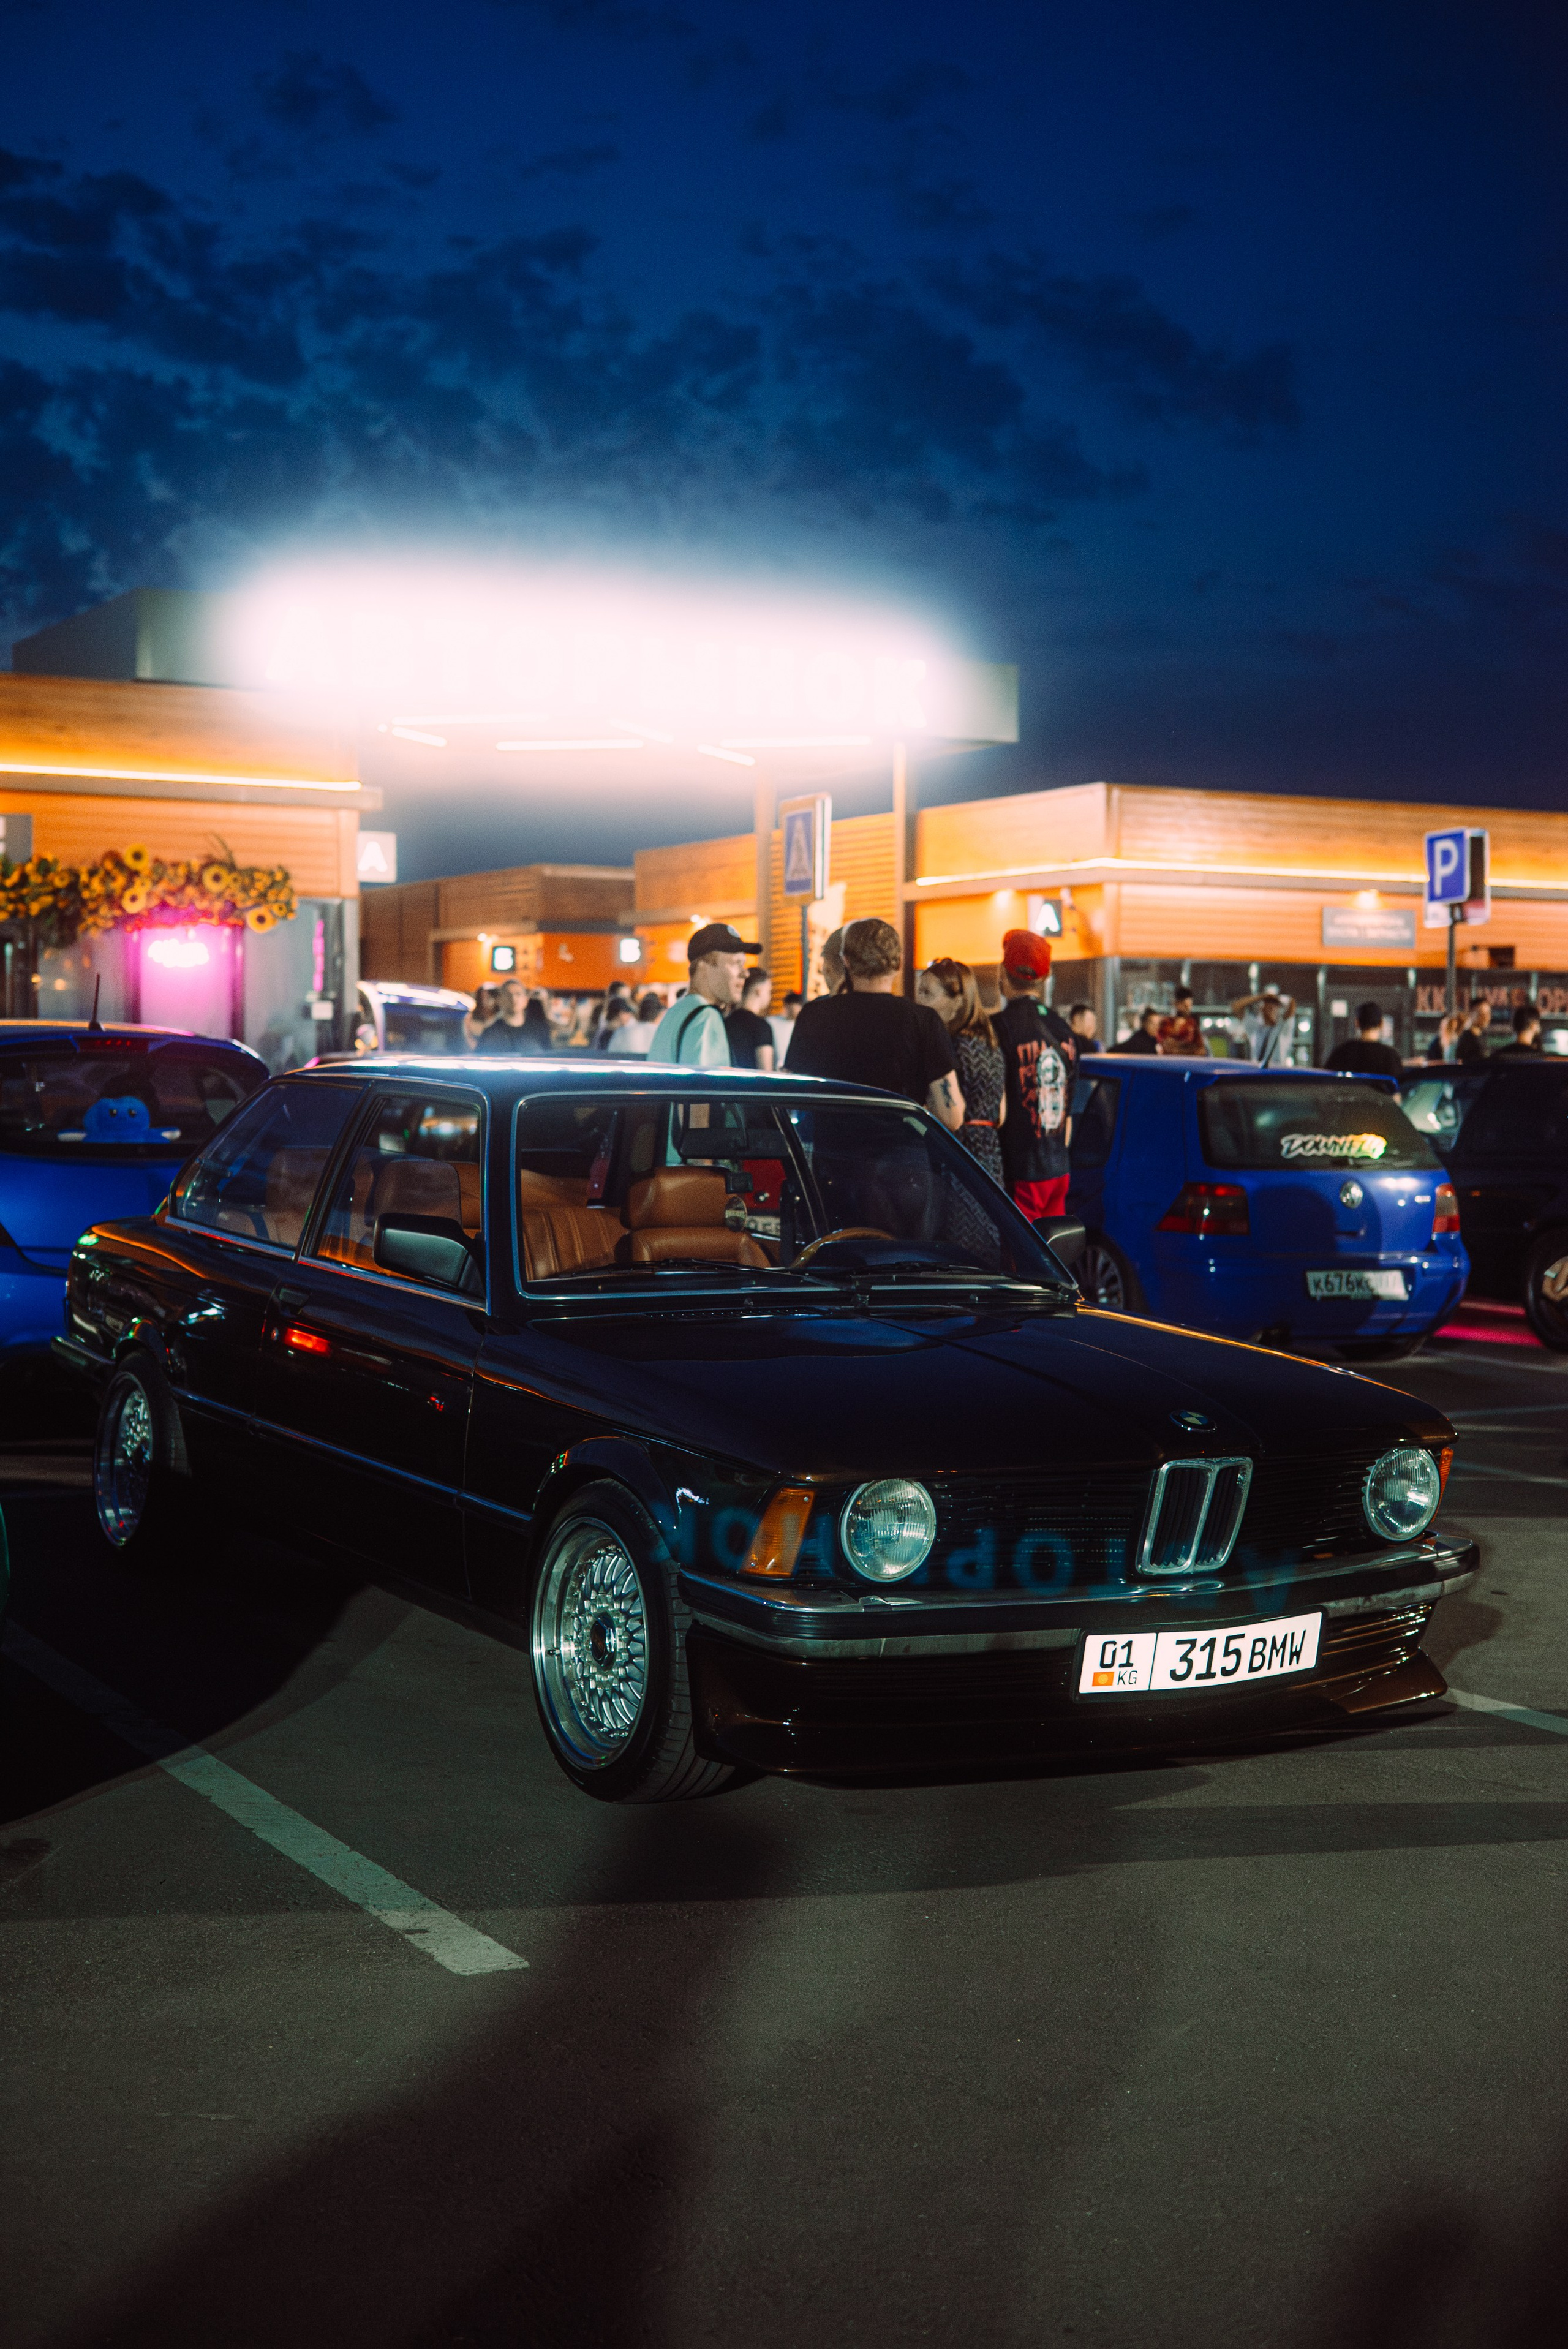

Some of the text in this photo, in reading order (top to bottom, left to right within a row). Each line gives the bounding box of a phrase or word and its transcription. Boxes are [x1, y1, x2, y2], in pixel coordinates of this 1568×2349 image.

[1434, 839, 1458, 898] P
[1100, 1640, 1134, 1668] 01
[1117, 1670, 1138, 1686] KG
